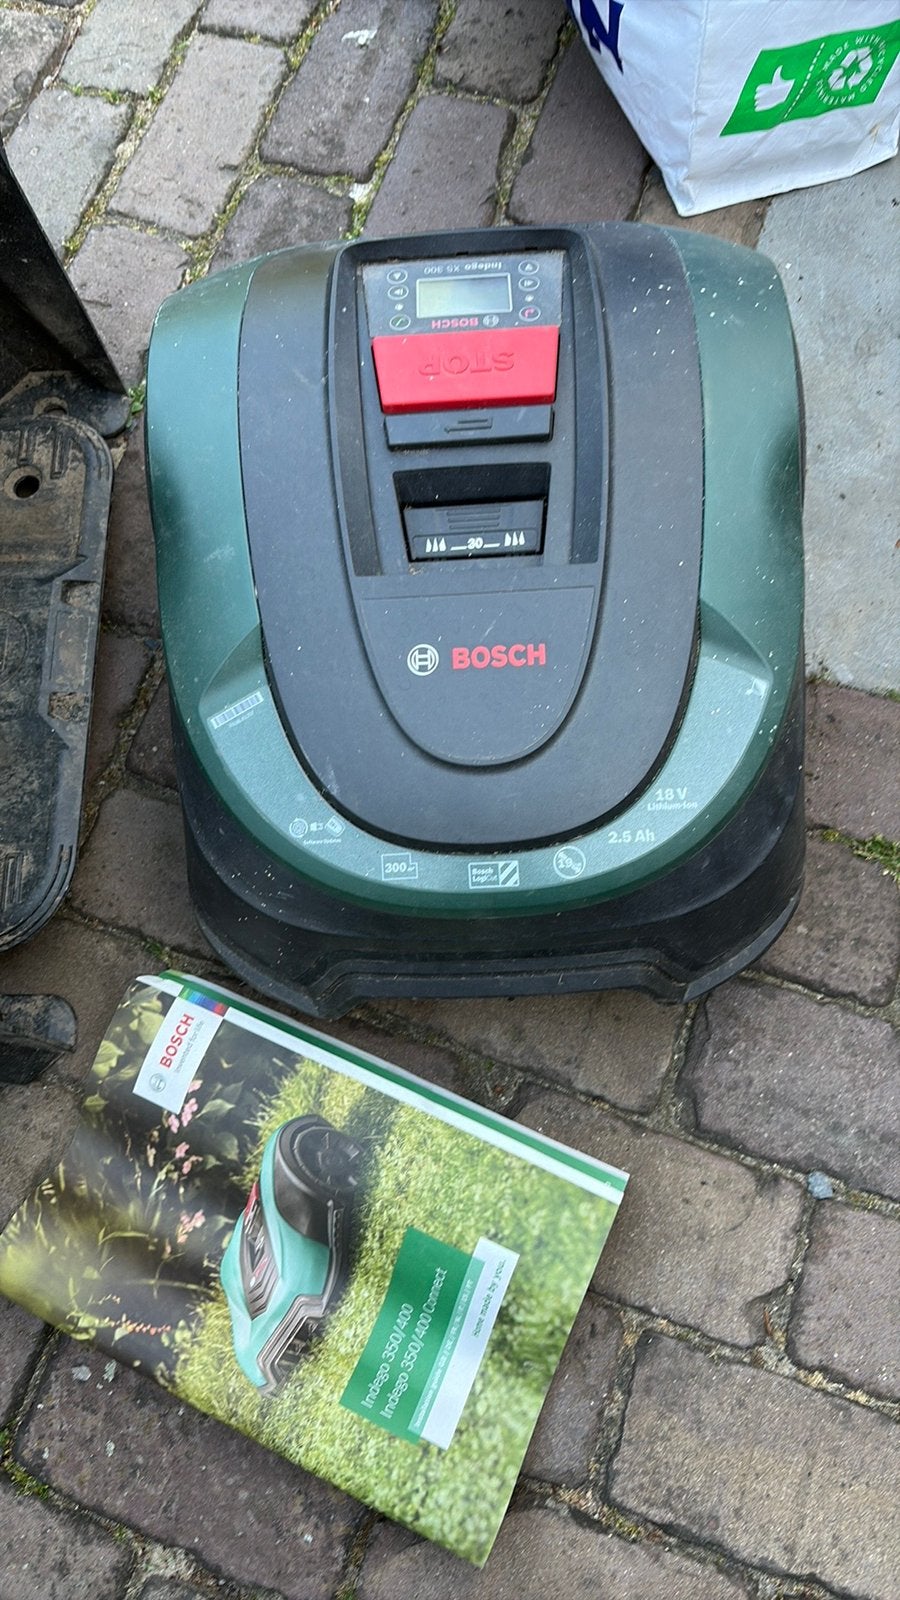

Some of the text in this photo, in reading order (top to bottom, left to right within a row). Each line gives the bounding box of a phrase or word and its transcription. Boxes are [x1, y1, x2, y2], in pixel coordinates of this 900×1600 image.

[464, 261, 502, 272] Indego
[431, 317, 479, 330] BOSCH
[418, 352, 515, 376] STOP
[452, 643, 547, 670] BOSCH
[655, 786, 688, 801] 18 V
[607, 829, 656, 844] 2.5 Ah
[160, 1013, 195, 1068] BOSCH
[379, 1267, 448, 1419] Indego 350/400 Connect
[360, 1302, 415, 1409] Indego 350/400
